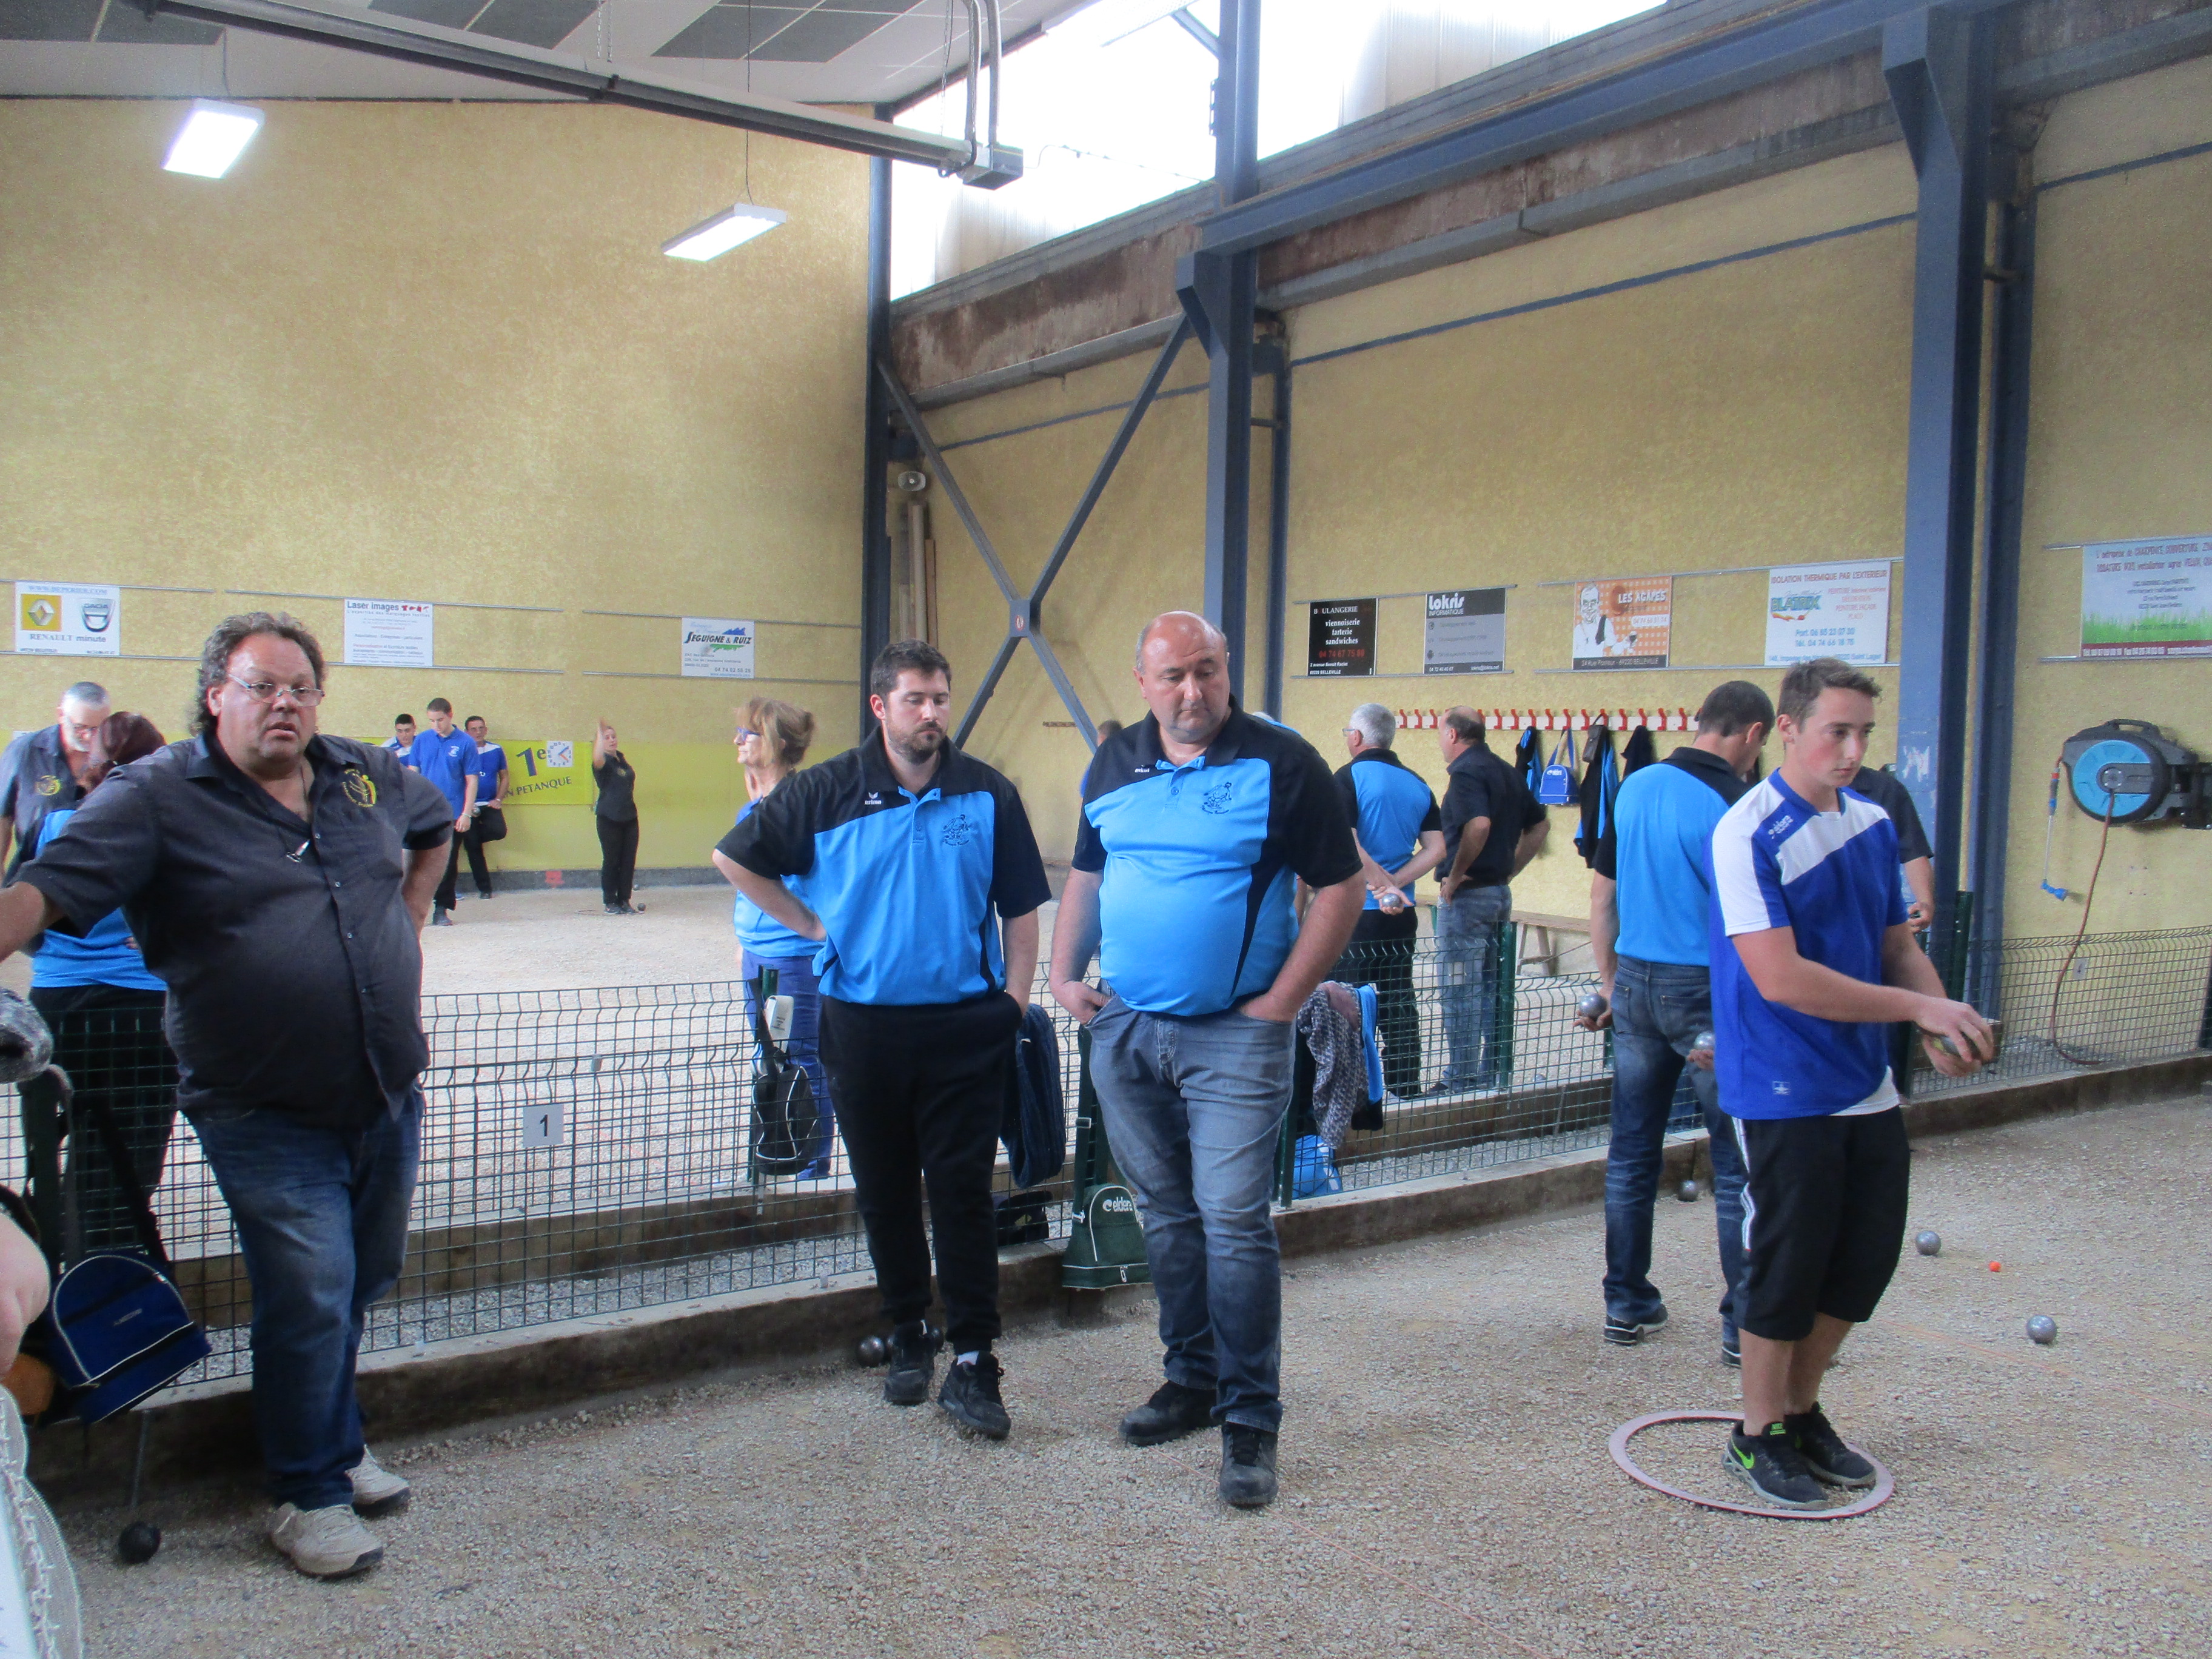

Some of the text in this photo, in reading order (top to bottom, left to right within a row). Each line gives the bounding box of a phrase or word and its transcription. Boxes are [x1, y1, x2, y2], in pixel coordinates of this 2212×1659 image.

[1771, 575, 1801, 584] ISOLATION
[1804, 572, 1837, 582] THERMIQUE
[1838, 572, 1850, 580] PAR
[1429, 592, 1464, 610] lokris
[1618, 590, 1667, 603] LES AGAPES
[371, 602, 399, 612] images
[684, 632, 725, 643] SEGUIGNE
[1326, 637, 1358, 645] sandwiches
[516, 776, 572, 795] PETANQUE
[540, 1114, 548, 1137] 1
